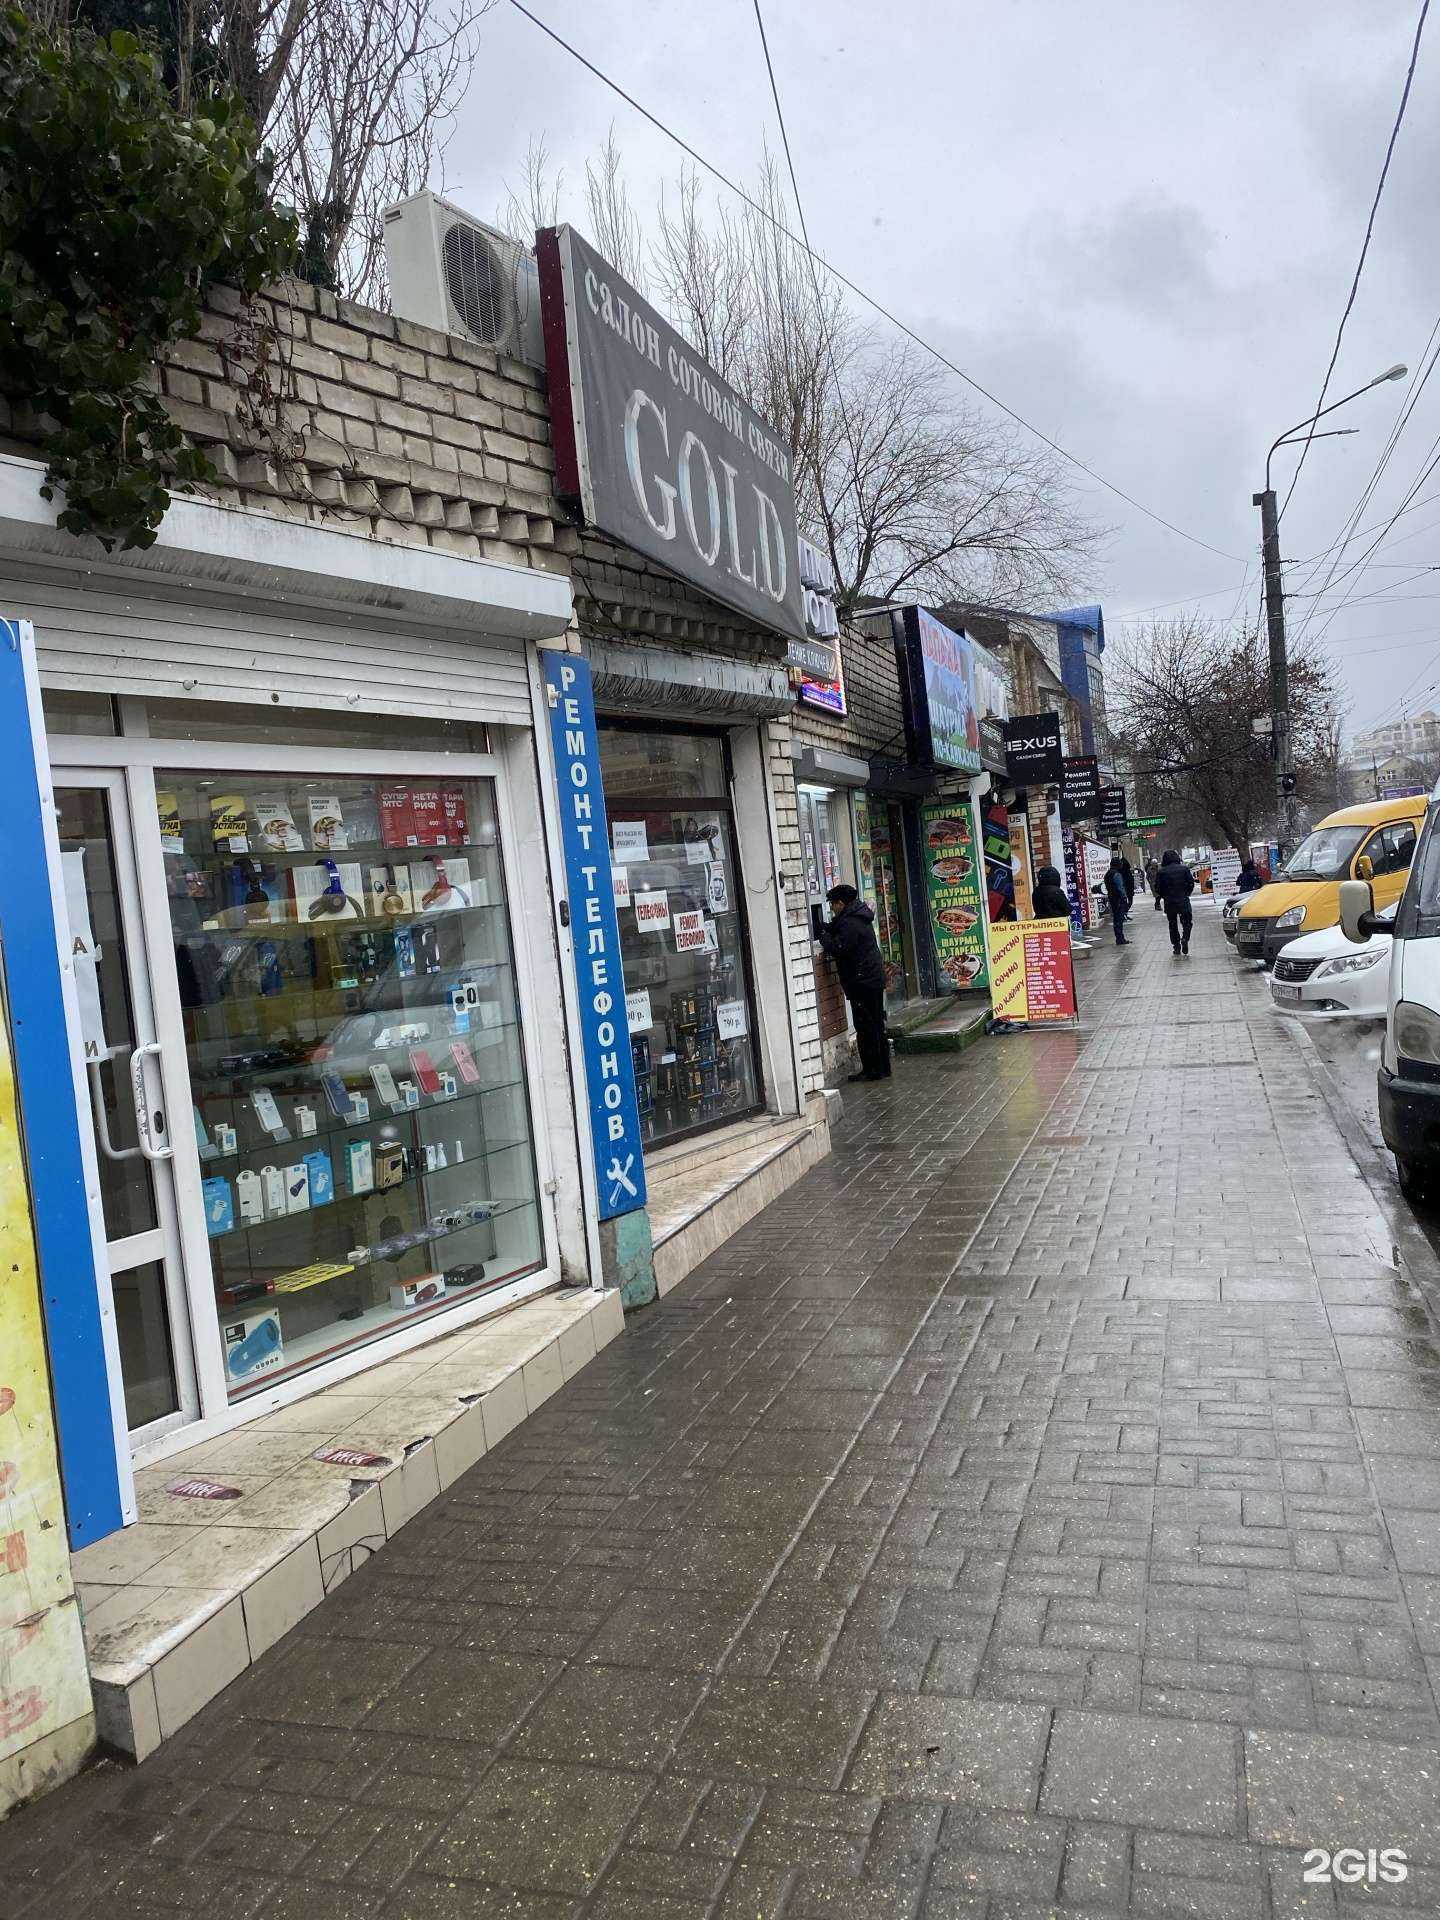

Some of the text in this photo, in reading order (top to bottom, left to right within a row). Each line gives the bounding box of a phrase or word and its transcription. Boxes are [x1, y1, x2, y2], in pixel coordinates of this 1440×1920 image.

[624, 388, 788, 603] GOLD
[928, 698, 967, 737] ШАУРМА
[1064, 771, 1091, 779] Ремонт
[1065, 781, 1092, 789] Скупка
[381, 792, 408, 801] СУПЕР
[1062, 790, 1096, 801] Продажа
[382, 800, 403, 808] МТС
[924, 807, 968, 821] ШАУРМА
[934, 885, 975, 898] ШАУРМА
[560, 666, 625, 1142] РЕМОНТ ТЕЛЕФОНОВ
[938, 895, 980, 907] БУЛОЧКЕ
[636, 902, 669, 921] ТЕЛЕФОНЫ
[679, 914, 698, 931] РЕМОНТ
[992, 921, 1066, 933] МЫ ОТКРЫЛИСЬ
[676, 930, 706, 948] ТЕЛЕФОНОВ
[941, 935, 978, 948] ШАУРМА
[950, 944, 984, 956] ТАРЕЛКЕ
[992, 935, 1021, 965] ВКУСНО
[995, 961, 1019, 987] СОЧНО
